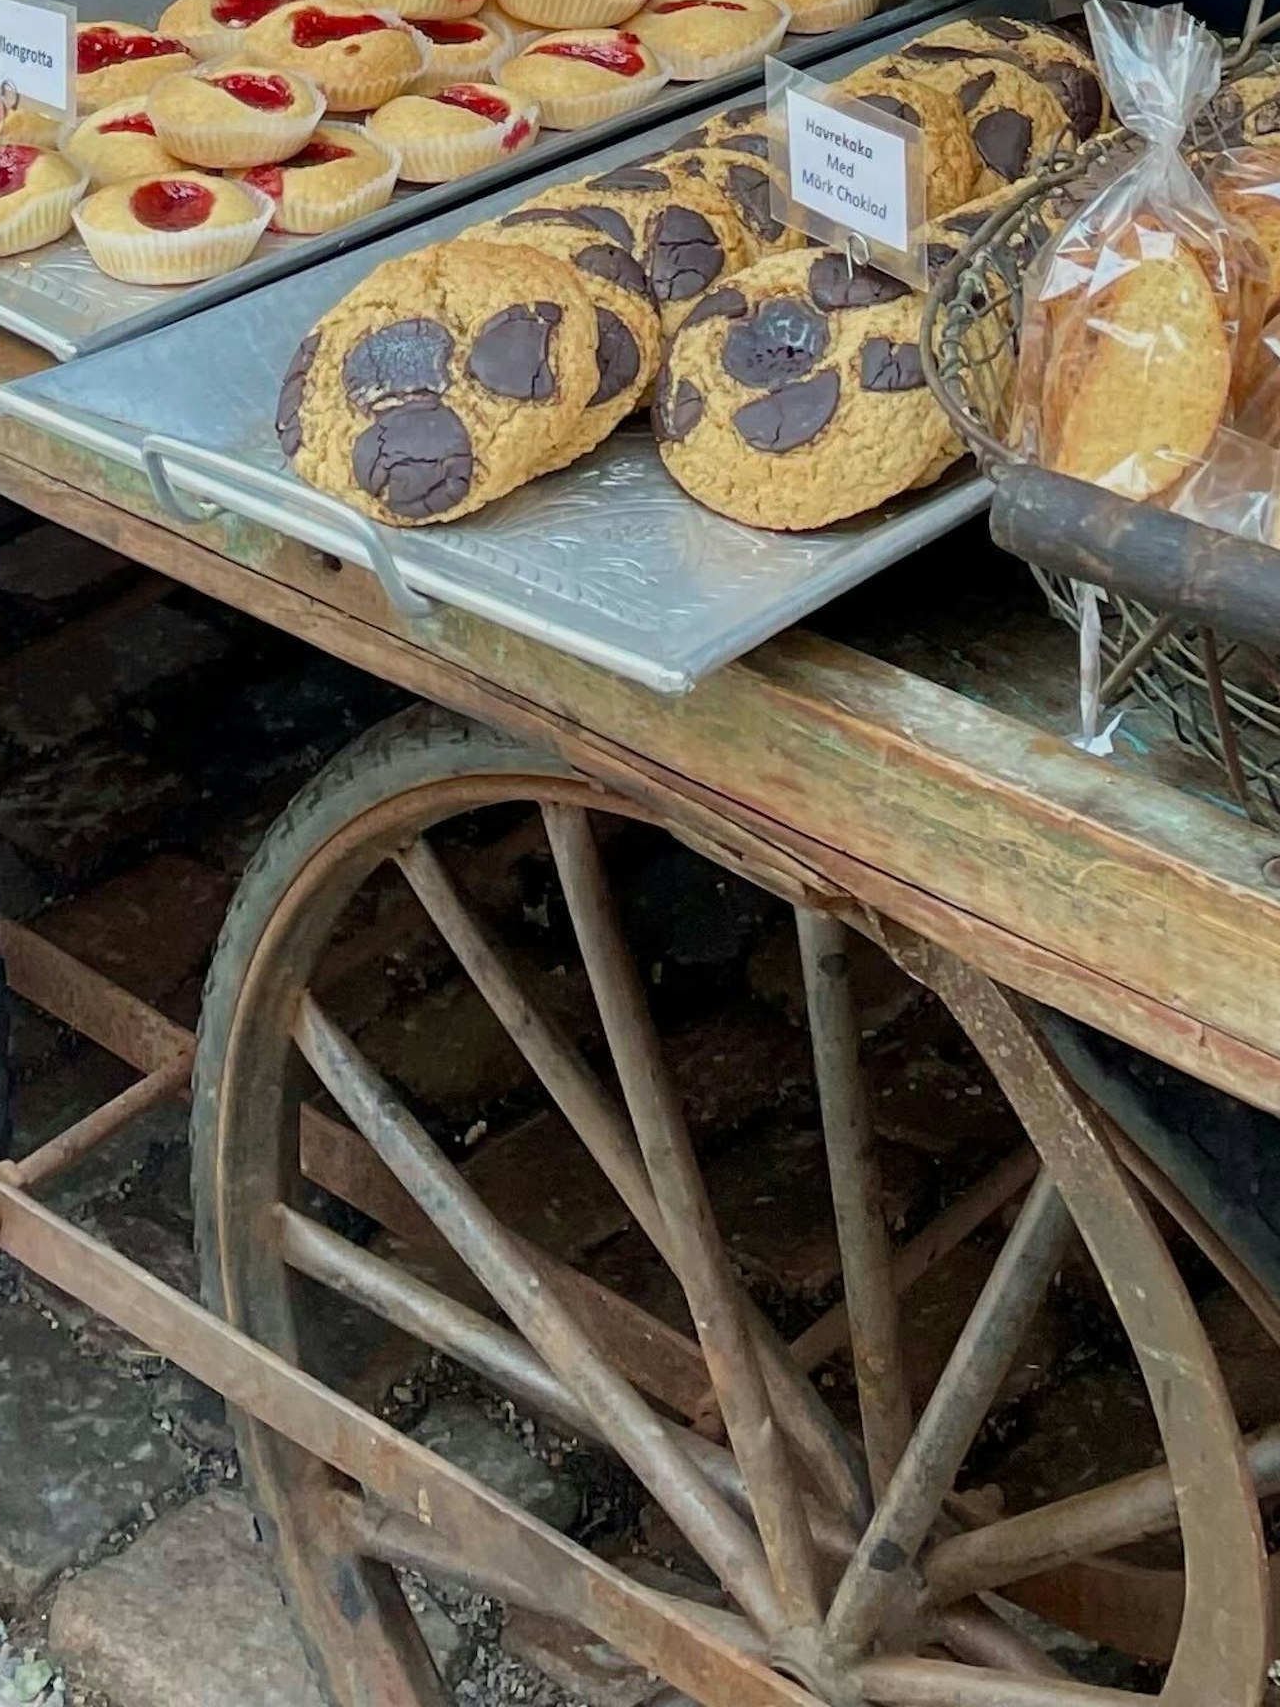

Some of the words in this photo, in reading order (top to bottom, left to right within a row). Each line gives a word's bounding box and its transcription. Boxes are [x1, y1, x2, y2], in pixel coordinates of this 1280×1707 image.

[805, 117, 874, 160] Havrekaka
[826, 152, 856, 179] Med
[801, 168, 834, 195] Mörk
[835, 184, 888, 220] Choklad
